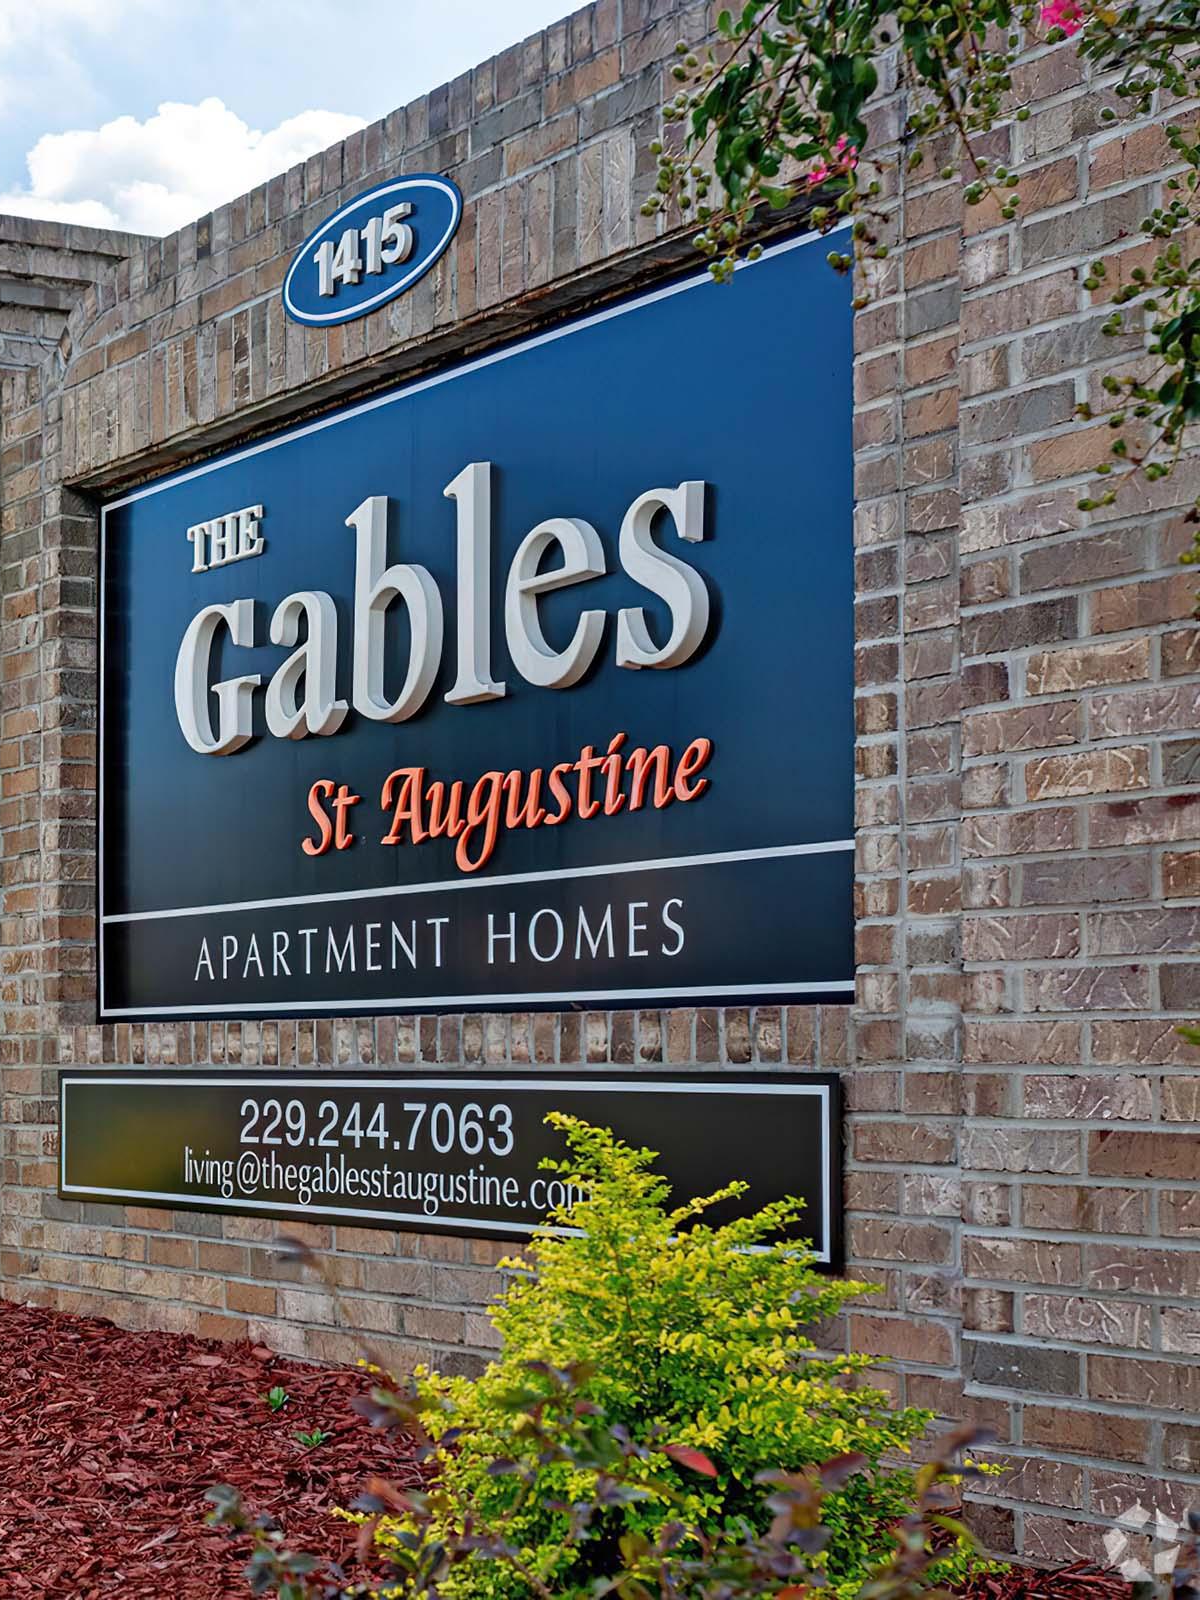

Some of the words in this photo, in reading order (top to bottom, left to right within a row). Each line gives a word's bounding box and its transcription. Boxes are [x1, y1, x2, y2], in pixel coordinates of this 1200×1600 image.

[313, 201, 414, 297] 1415
[186, 504, 265, 573] THE
[174, 461, 710, 756] Gables
[301, 779, 360, 856] St
[194, 917, 450, 981] APARTMENT
[487, 898, 685, 965] HOMES
[238, 1098, 515, 1157] 229.244.7063
